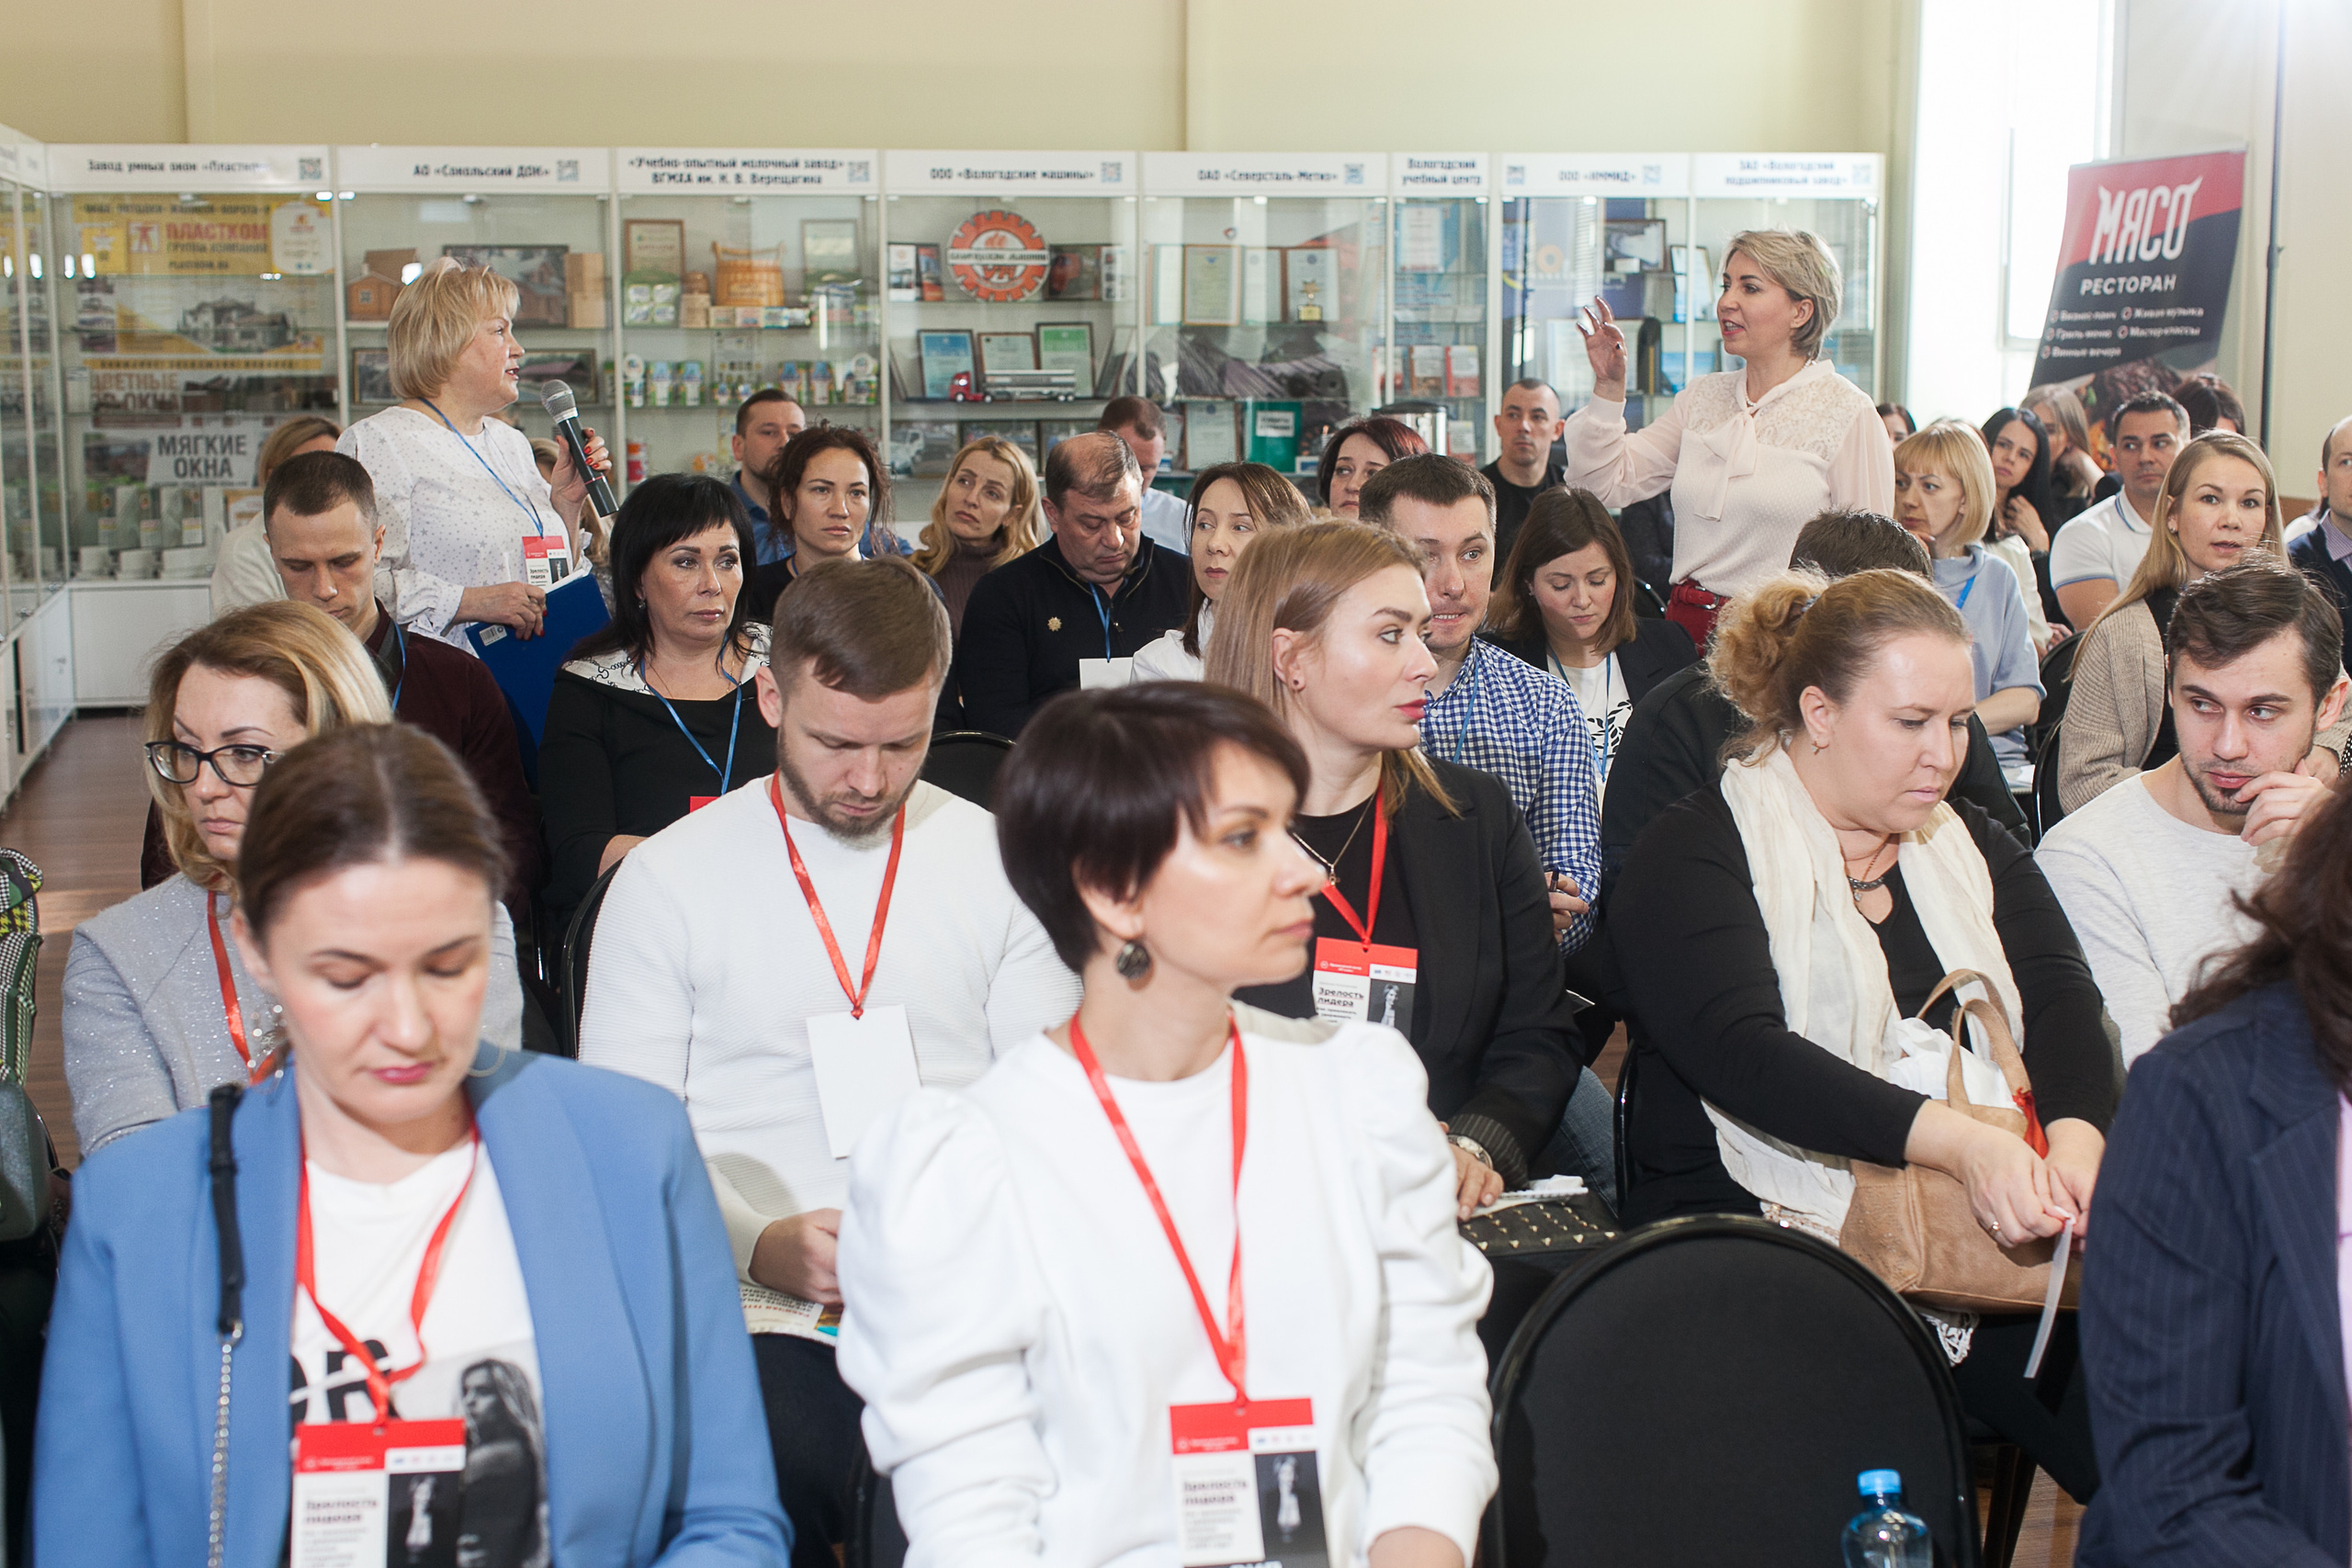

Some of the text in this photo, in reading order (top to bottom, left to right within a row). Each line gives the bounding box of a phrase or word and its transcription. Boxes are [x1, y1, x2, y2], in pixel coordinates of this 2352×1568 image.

[87, 159, 122, 174] Завод
[128, 161, 164, 175] умных
[170, 162, 197, 172] окон
[413, 164, 430, 175] АО
[741, 158, 799, 169] молочный
[1408, 158, 1476, 171] Вологодский
[930, 167, 954, 180] ООО
[1198, 169, 1220, 182] ОАО
[1402, 173, 1483, 186] учебный центр
[1558, 171, 1579, 182] ООО
[2087, 175, 2203, 265] МЯСО
[166, 222, 268, 241] ПЛАСТКОМ
[2079, 274, 2177, 296] РЕСТОРАН
[157, 434, 247, 457] МЯГКИЕ
[174, 457, 233, 479] ОКНА
[1318, 987, 1364, 1000] Зрелость
[1317, 997, 1354, 1008] лидера
